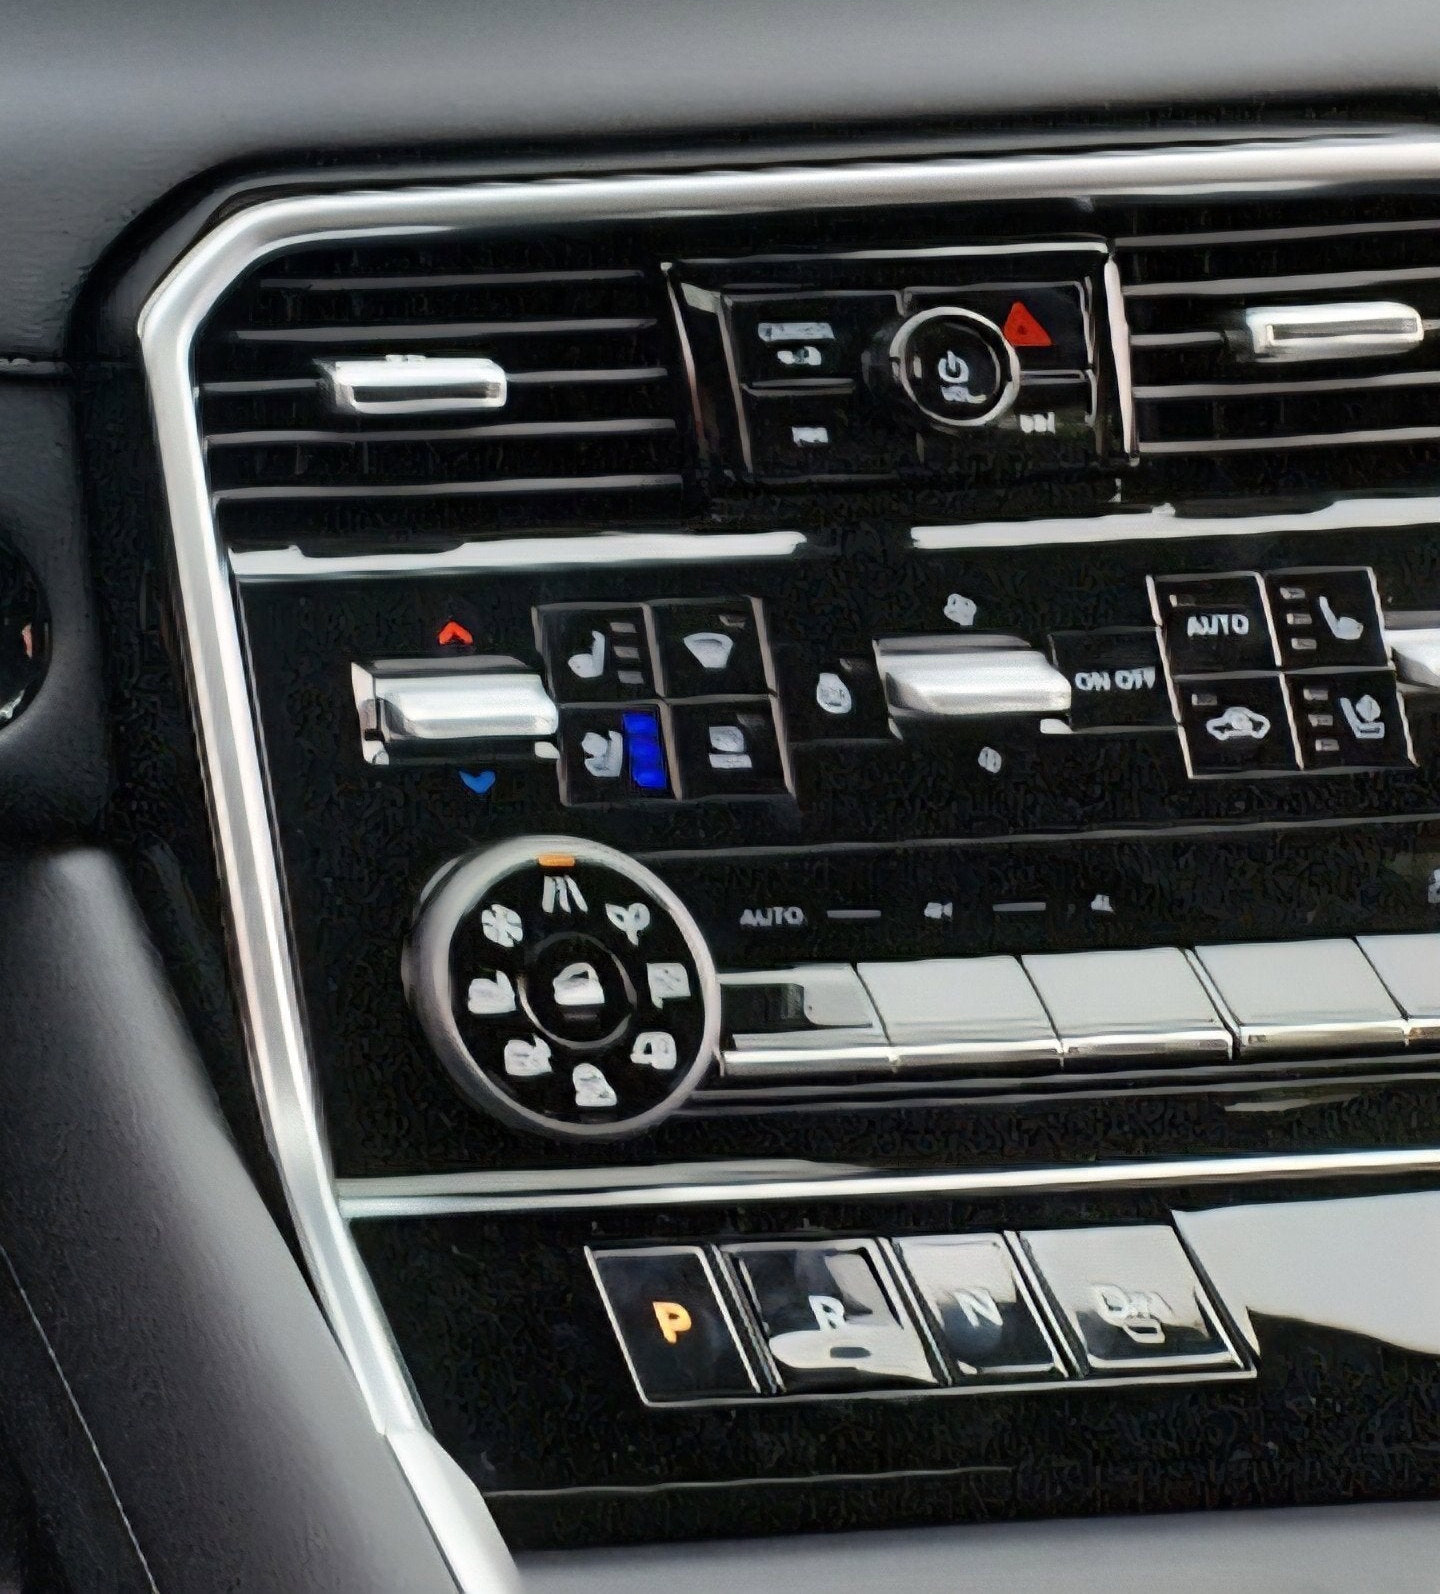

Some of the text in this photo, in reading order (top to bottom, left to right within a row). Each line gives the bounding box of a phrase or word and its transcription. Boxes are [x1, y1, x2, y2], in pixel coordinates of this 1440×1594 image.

[1187, 613, 1250, 637] AUTO
[739, 905, 807, 928] AUTO
[651, 1300, 693, 1345] P
[953, 1287, 1004, 1328] N
